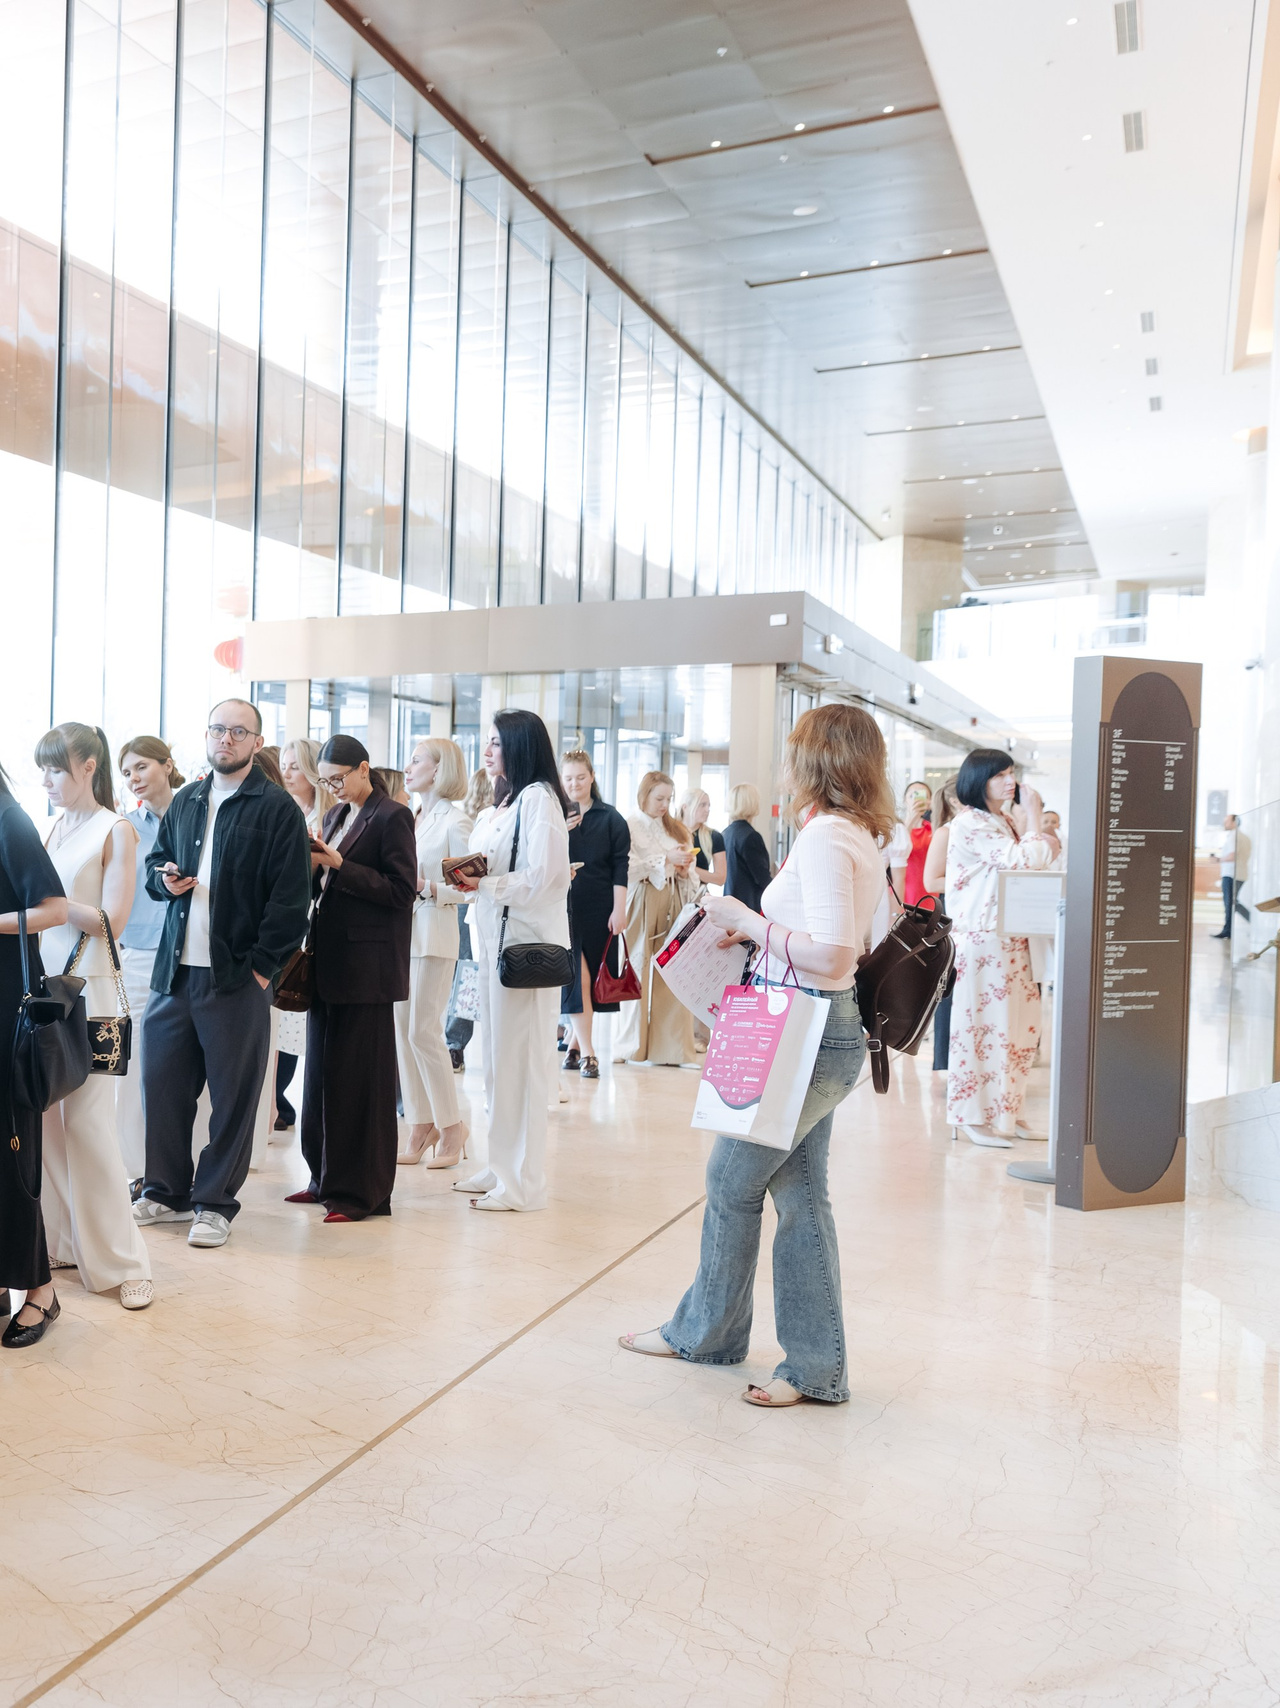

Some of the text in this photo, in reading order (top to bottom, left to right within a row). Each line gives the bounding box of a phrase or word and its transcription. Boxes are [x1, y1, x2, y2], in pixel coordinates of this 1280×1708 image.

[1112, 728, 1123, 738] 3F
[1109, 818, 1120, 828] 2F
[1105, 930, 1114, 940] 1F
